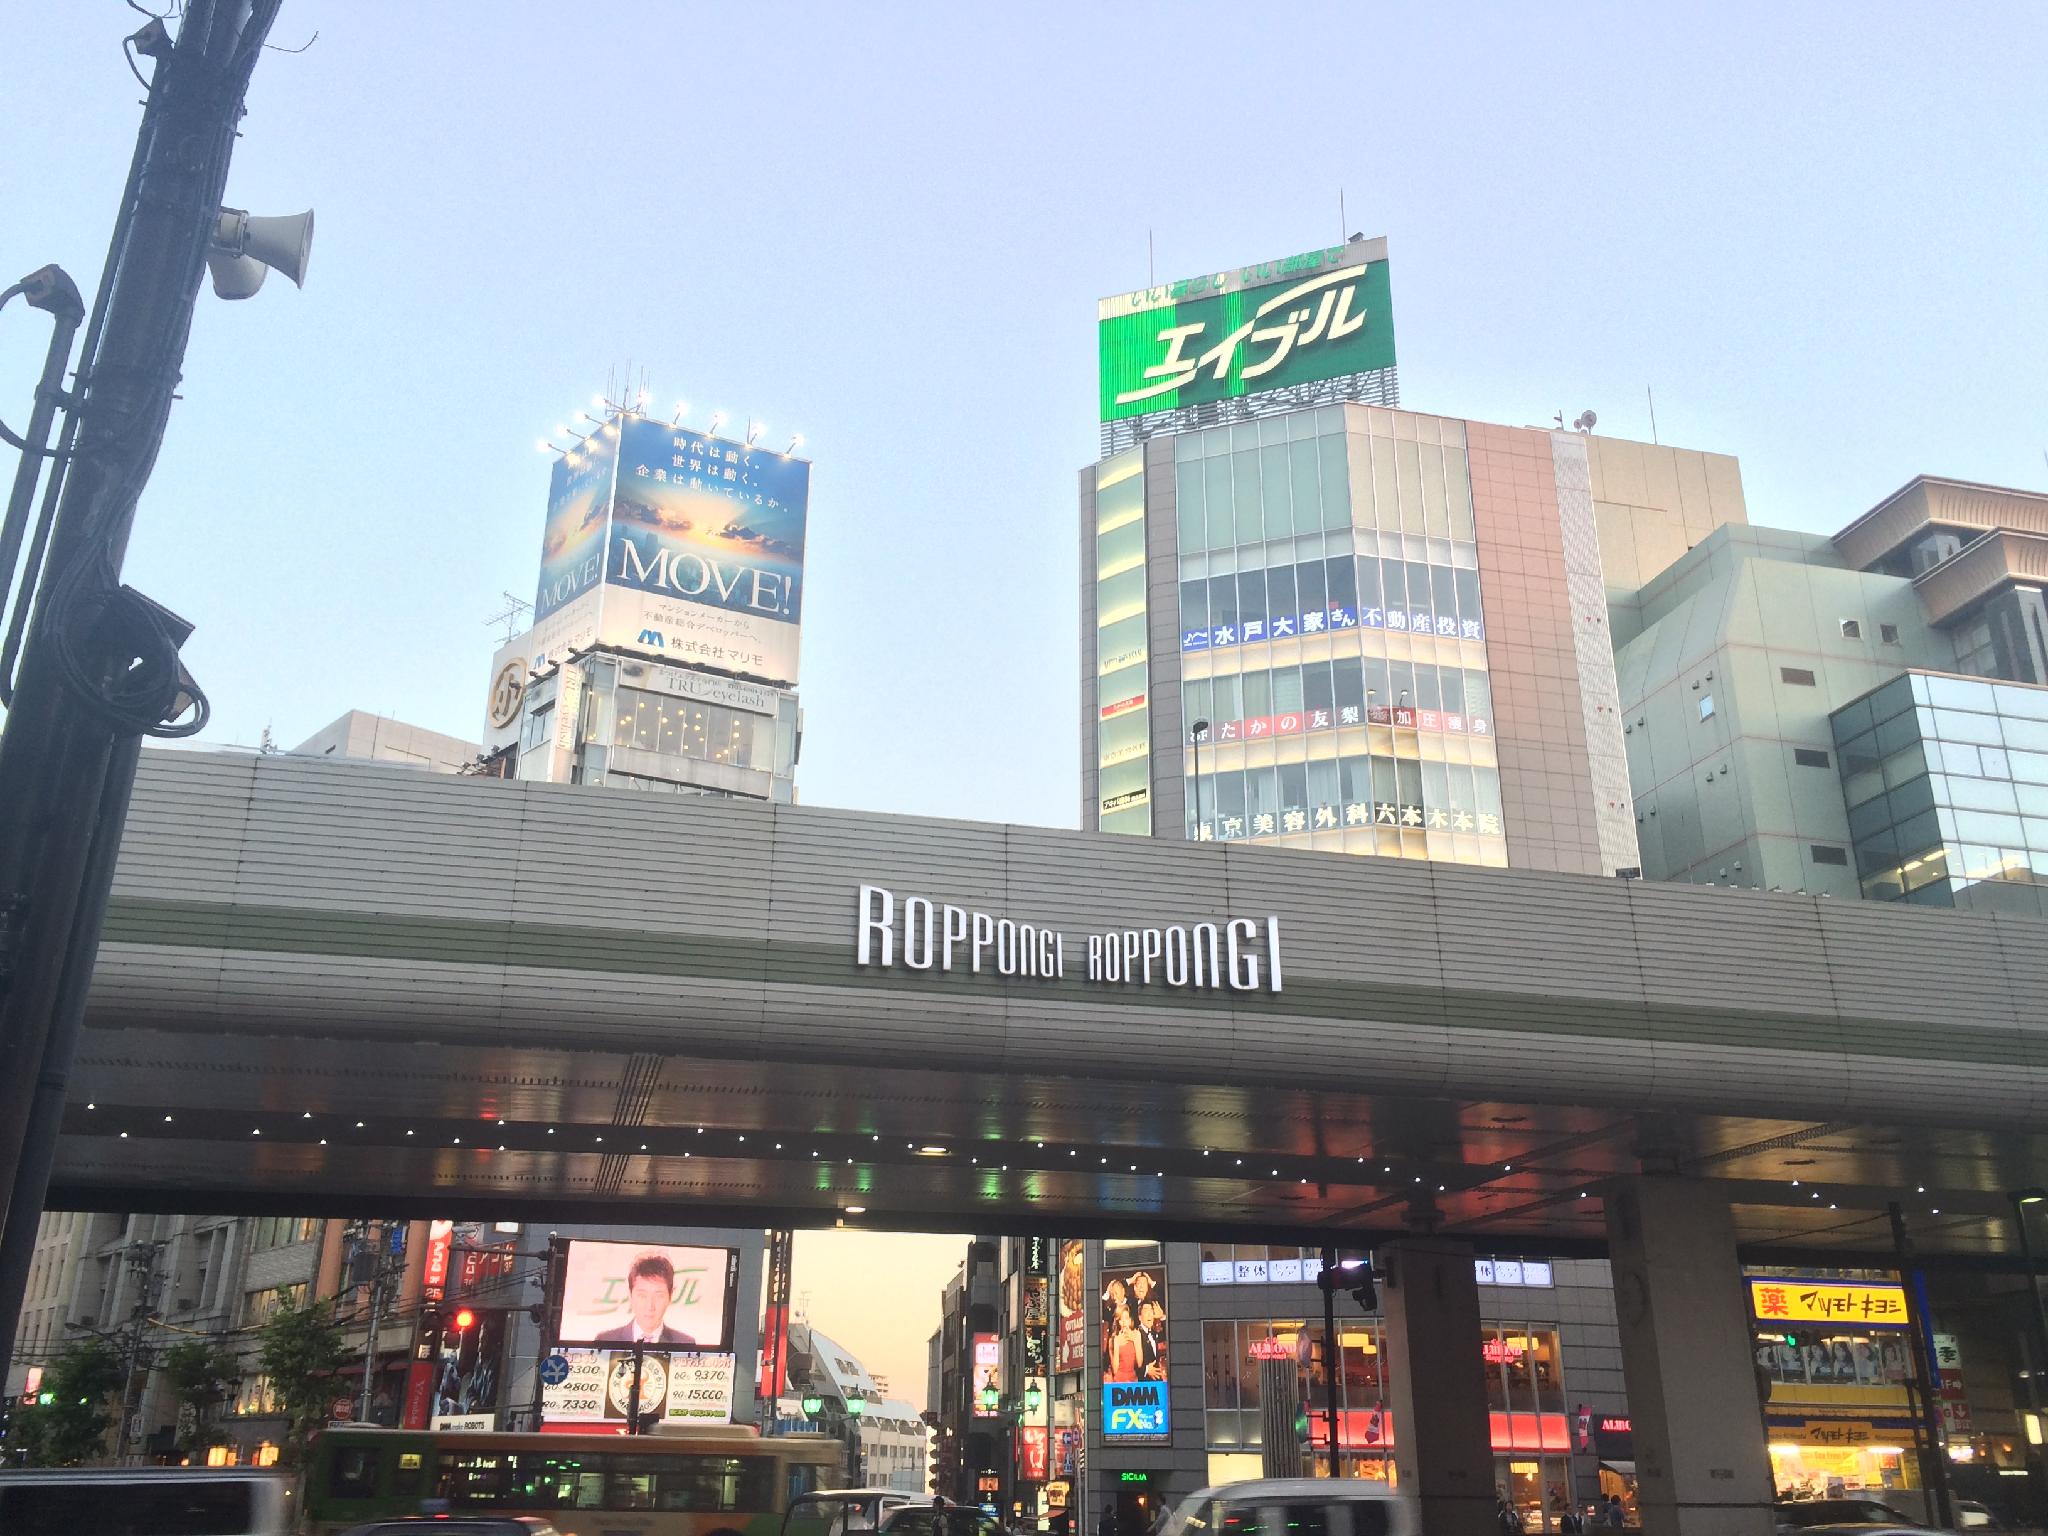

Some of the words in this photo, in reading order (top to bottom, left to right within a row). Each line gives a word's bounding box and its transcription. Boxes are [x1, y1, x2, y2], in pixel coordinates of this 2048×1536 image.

[1115, 264, 1367, 405] エイブル
[671, 453, 757, 486] 世界は動く。
[673, 436, 759, 469] 時代は動く。
[636, 463, 788, 512] 企業は動いているか。
[541, 552, 600, 614] MOVE!
[617, 538, 792, 615] MOVE!
[1214, 608, 1356, 645] 水戸大家さん
[1362, 608, 1481, 639] 不動産投資
[1221, 706, 1359, 739] たかの友梨
[1194, 802, 1369, 841] 東京美容外科
[1375, 803, 1500, 835] 六本木本院
[858, 882, 1063, 978] ROPPONGI
[1088, 915, 1282, 992] ROPPONGI
[1759, 1287, 1789, 1315] 薬
[1800, 1290, 1901, 1318] マツモトキヨシ
[1112, 1386, 1160, 1406] DMM
[1111, 1408, 1143, 1430] FX
